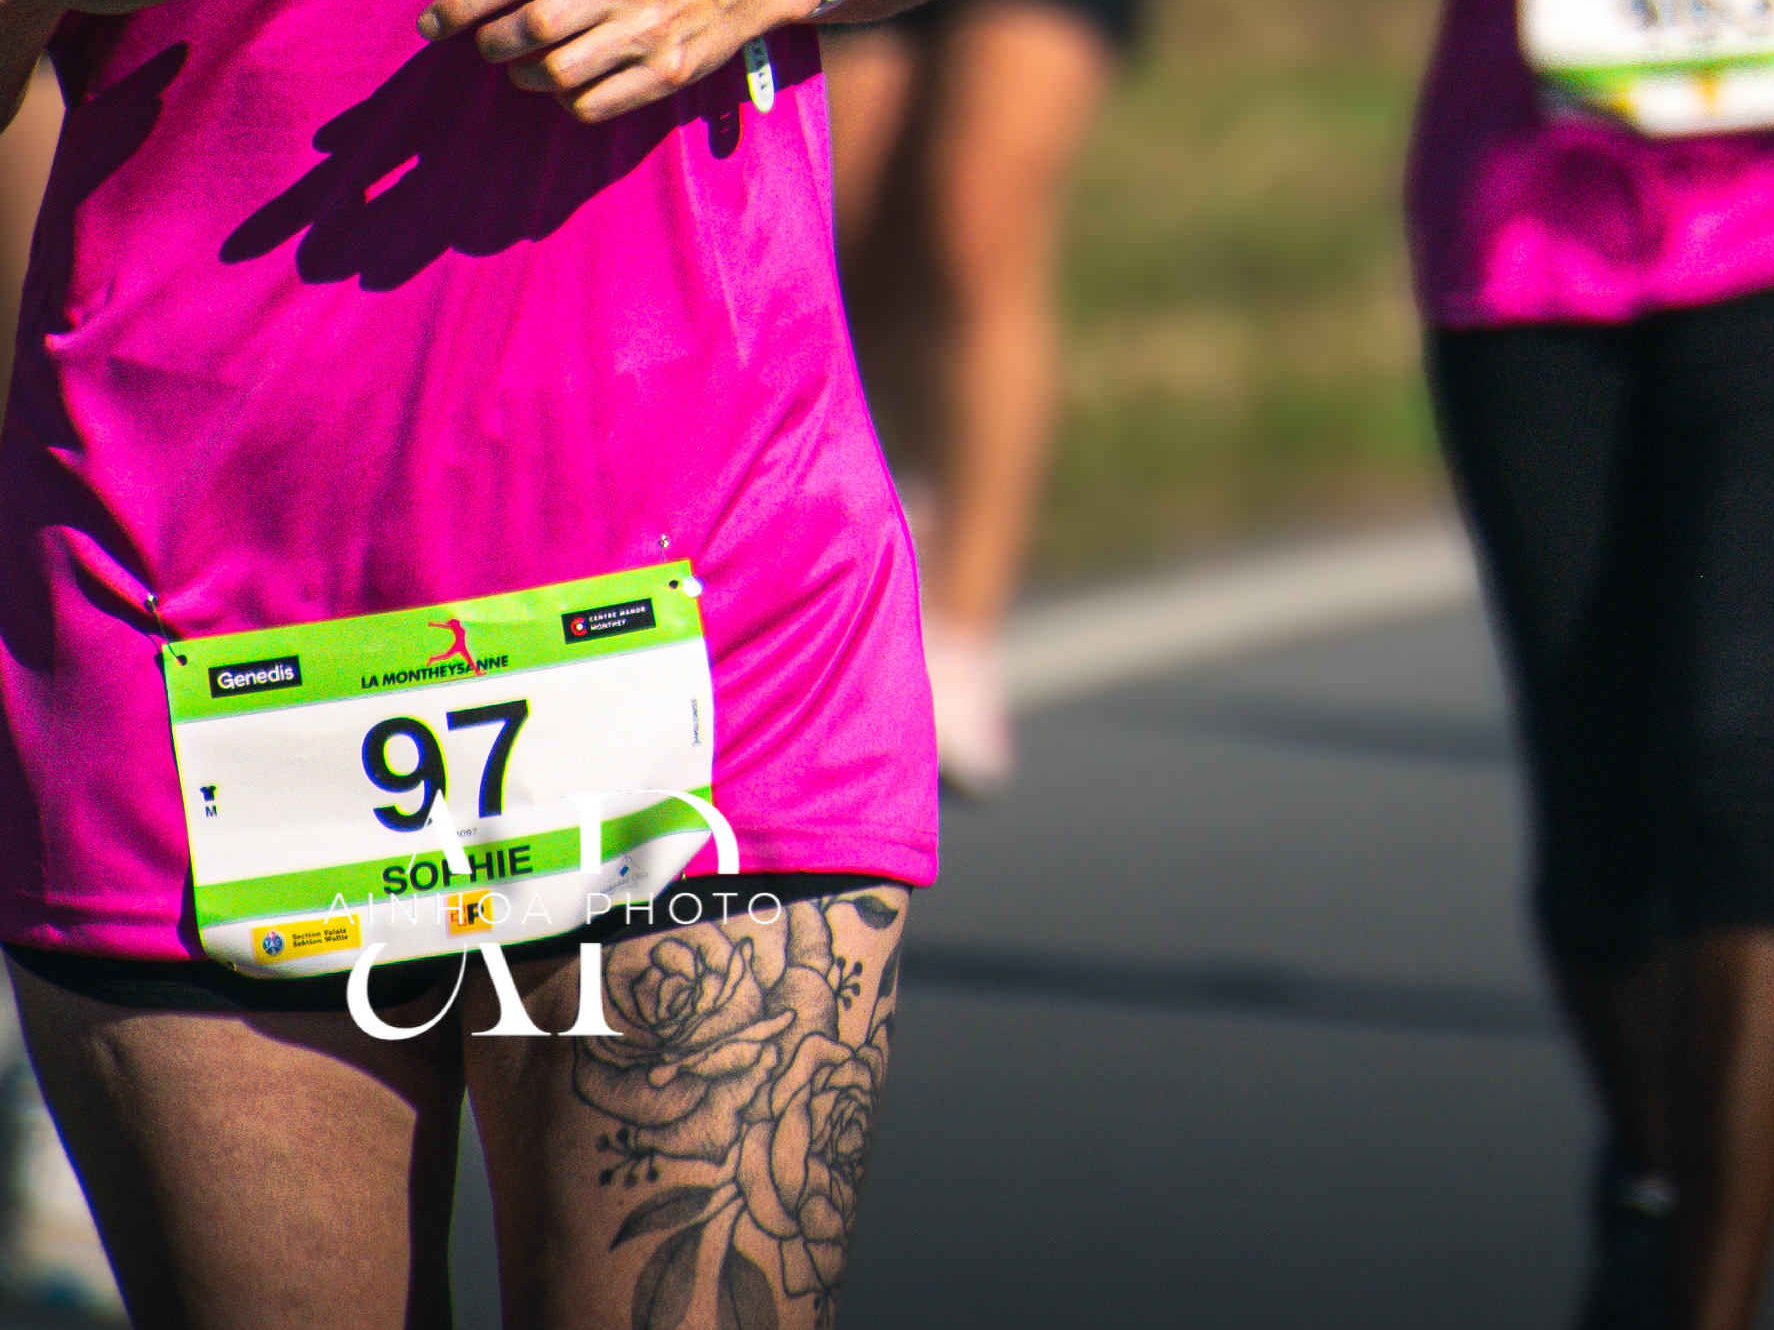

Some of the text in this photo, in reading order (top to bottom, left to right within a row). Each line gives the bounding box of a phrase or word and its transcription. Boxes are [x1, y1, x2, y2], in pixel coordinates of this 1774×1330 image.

[216, 663, 296, 691] Genedis
[361, 654, 510, 690] LA MONTHEYSANNE
[361, 699, 530, 834] 97
[205, 804, 217, 818] M
